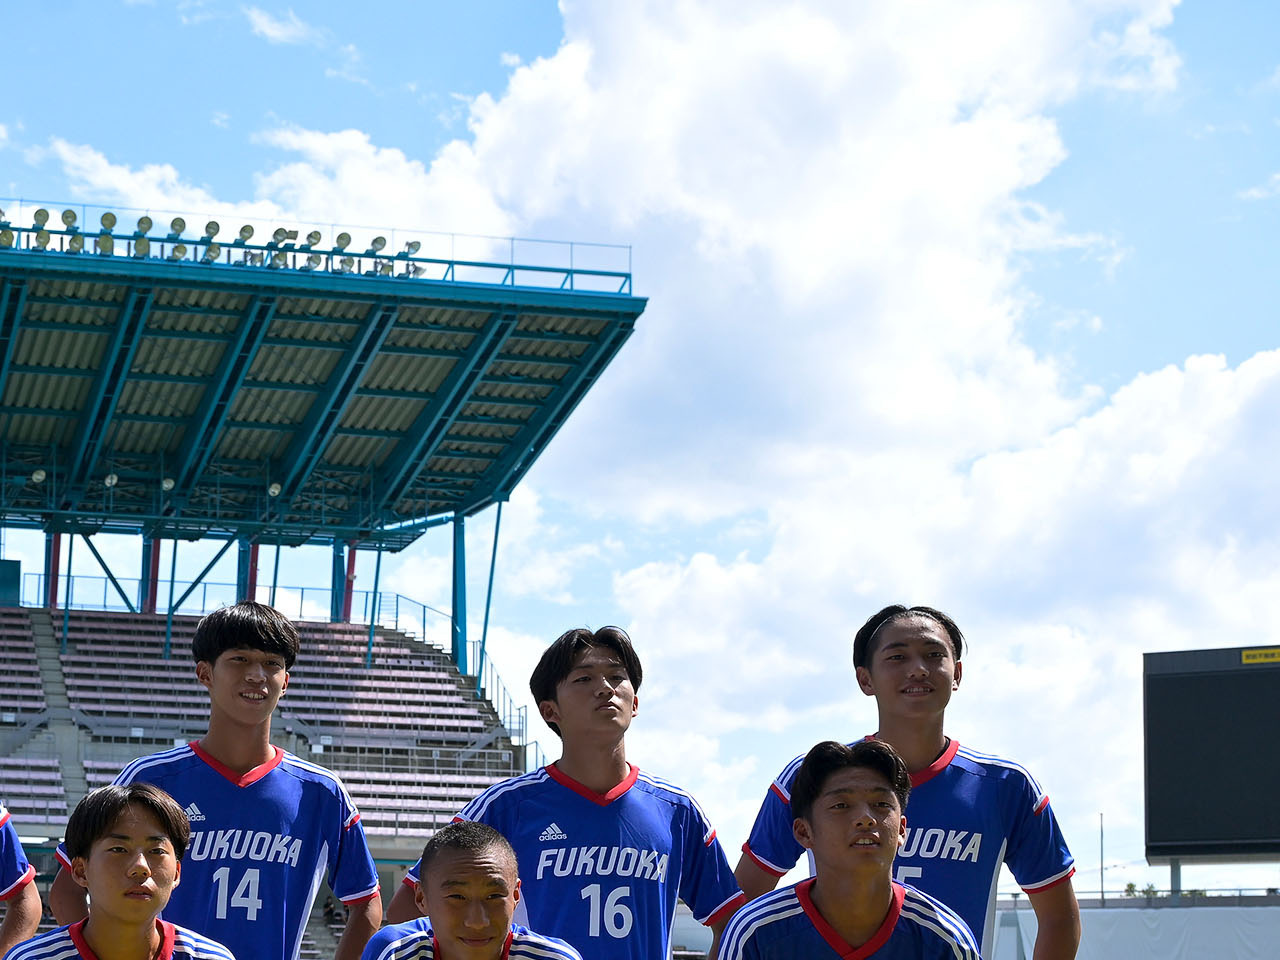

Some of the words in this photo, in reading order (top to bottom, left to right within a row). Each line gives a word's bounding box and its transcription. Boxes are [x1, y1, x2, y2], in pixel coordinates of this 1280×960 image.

[538, 833, 568, 842] adidas
[536, 846, 670, 883] FUKUOKA
[212, 866, 262, 921] 14
[580, 883, 633, 939] 16
